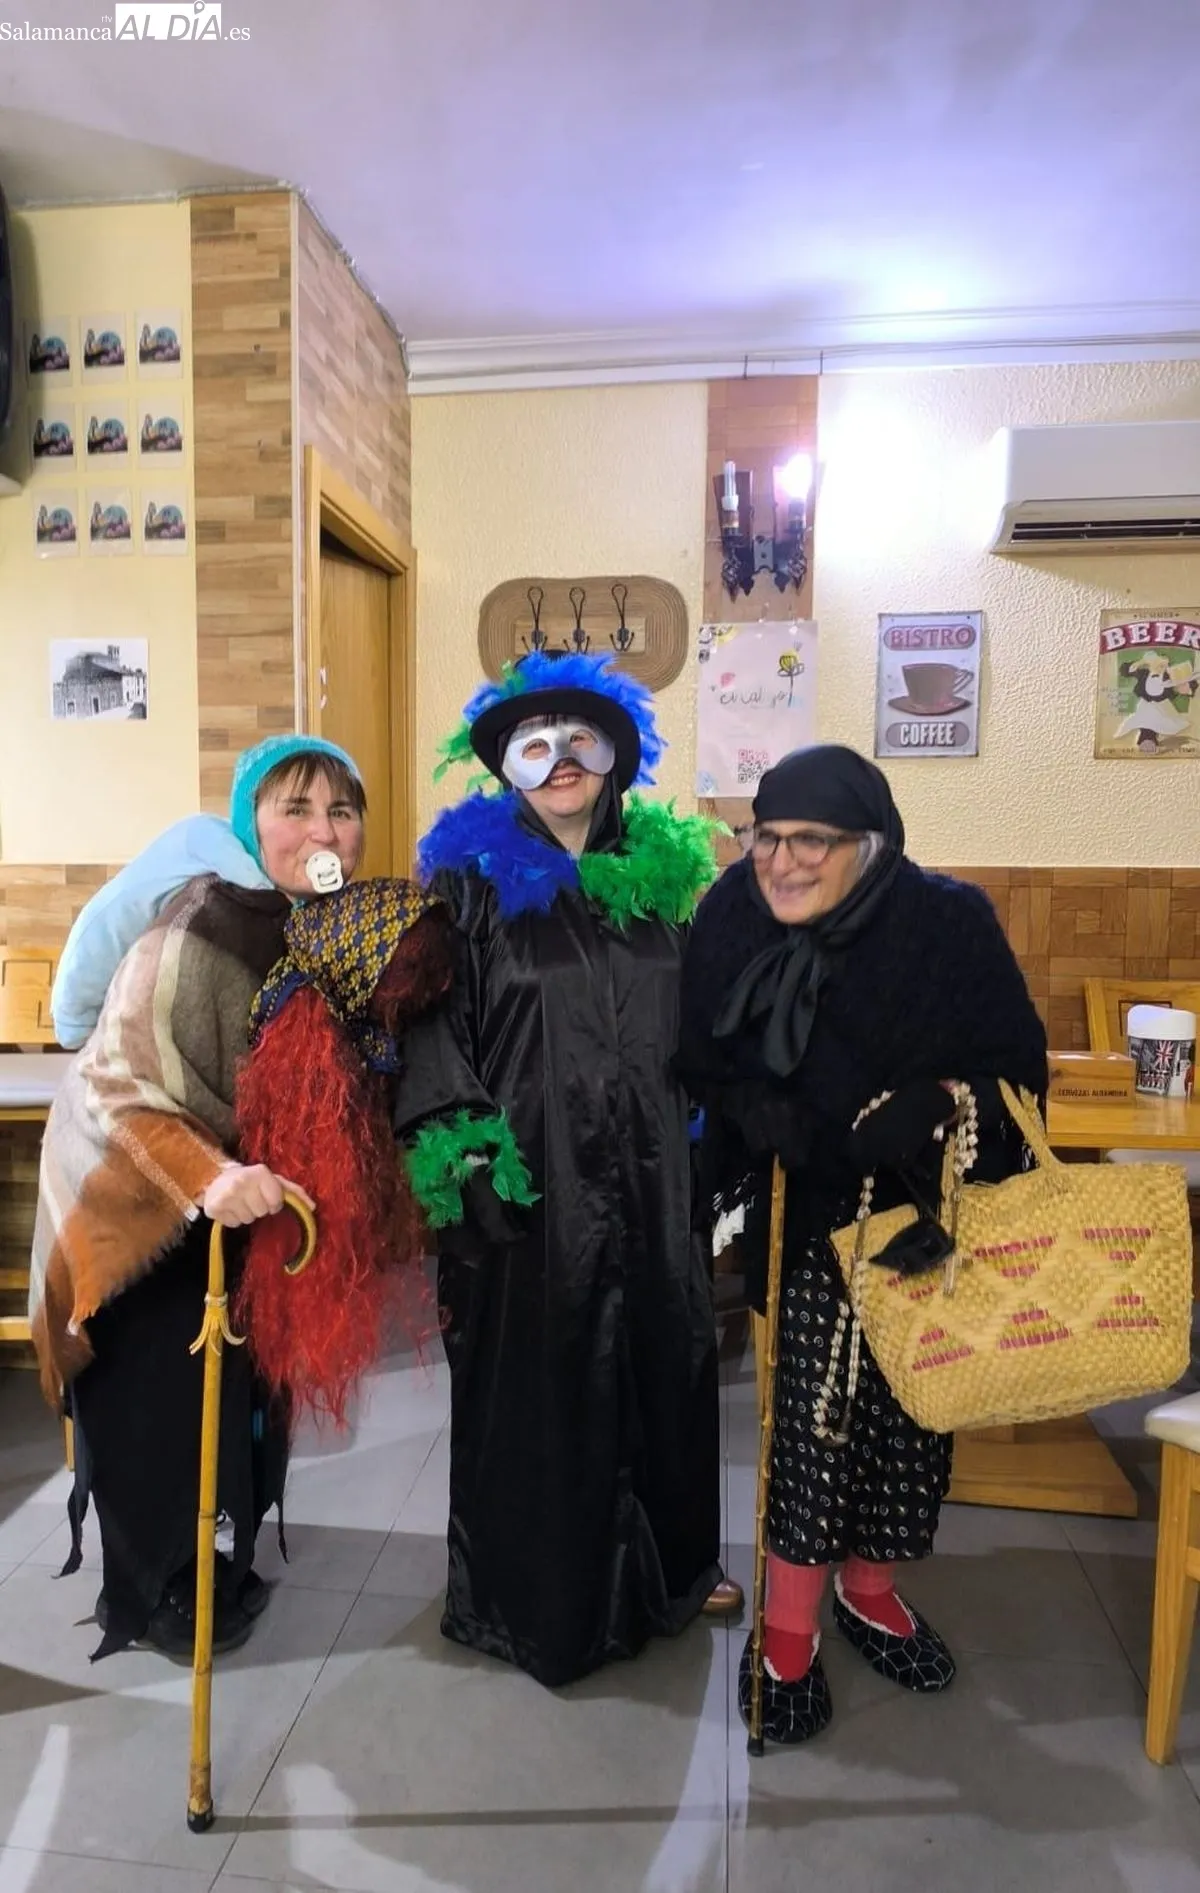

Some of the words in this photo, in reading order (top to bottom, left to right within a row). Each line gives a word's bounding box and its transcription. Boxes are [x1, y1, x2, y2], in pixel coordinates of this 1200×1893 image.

[890, 627, 972, 648] BISTRO
[1101, 621, 1200, 650] BEER
[900, 722, 956, 747] COFFEE
